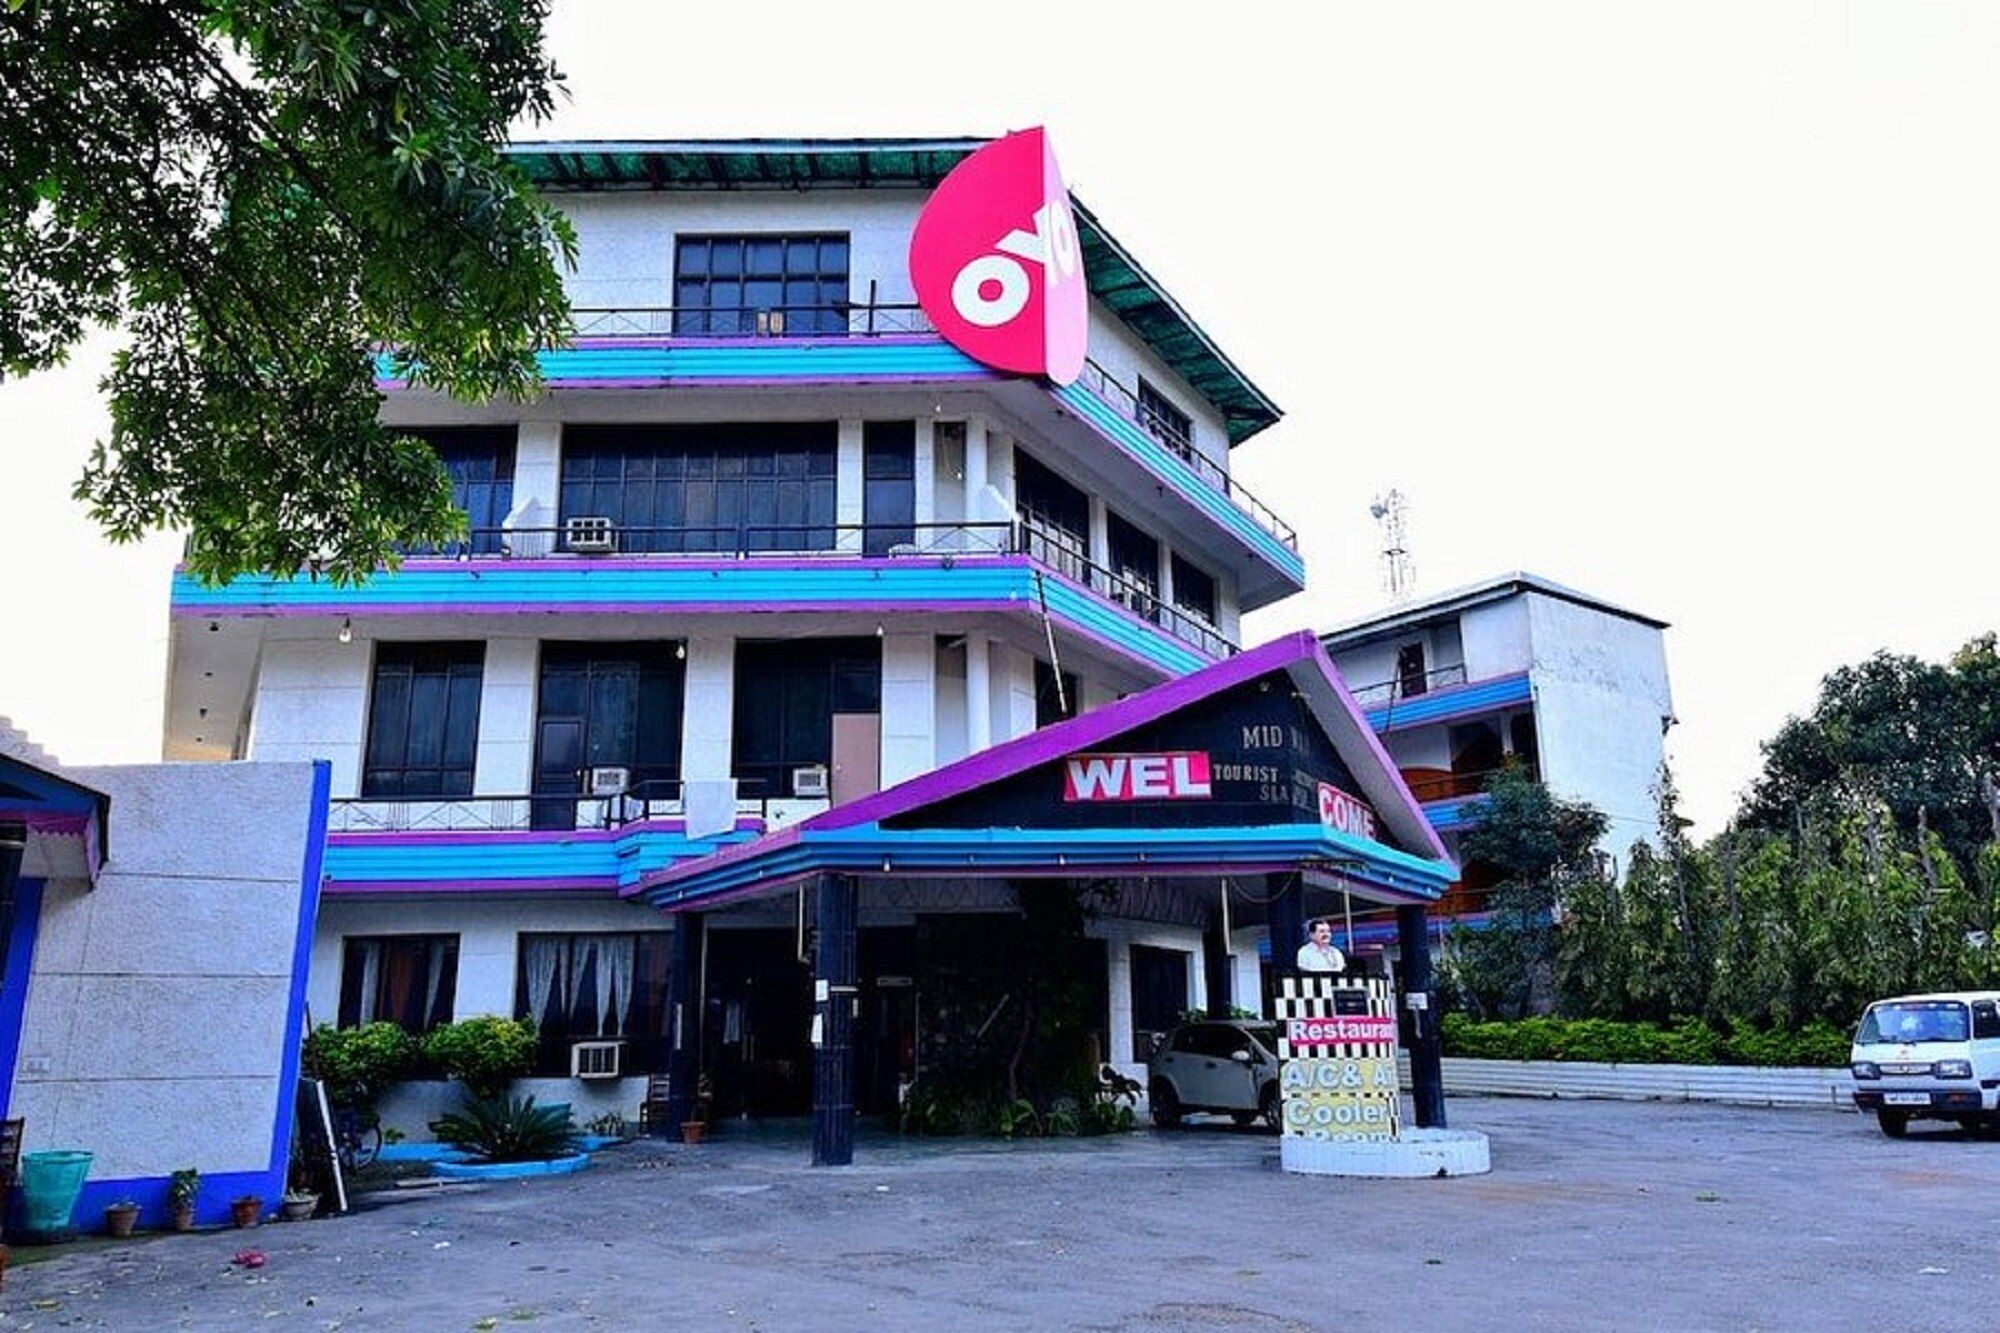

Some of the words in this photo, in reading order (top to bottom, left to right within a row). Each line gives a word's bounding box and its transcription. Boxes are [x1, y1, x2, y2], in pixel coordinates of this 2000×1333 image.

[950, 201, 1077, 327] OYO
[1243, 725, 1283, 749] MID
[1066, 757, 1212, 798] WEL
[1213, 763, 1279, 782] TOURIST
[1318, 788, 1376, 842] COME
